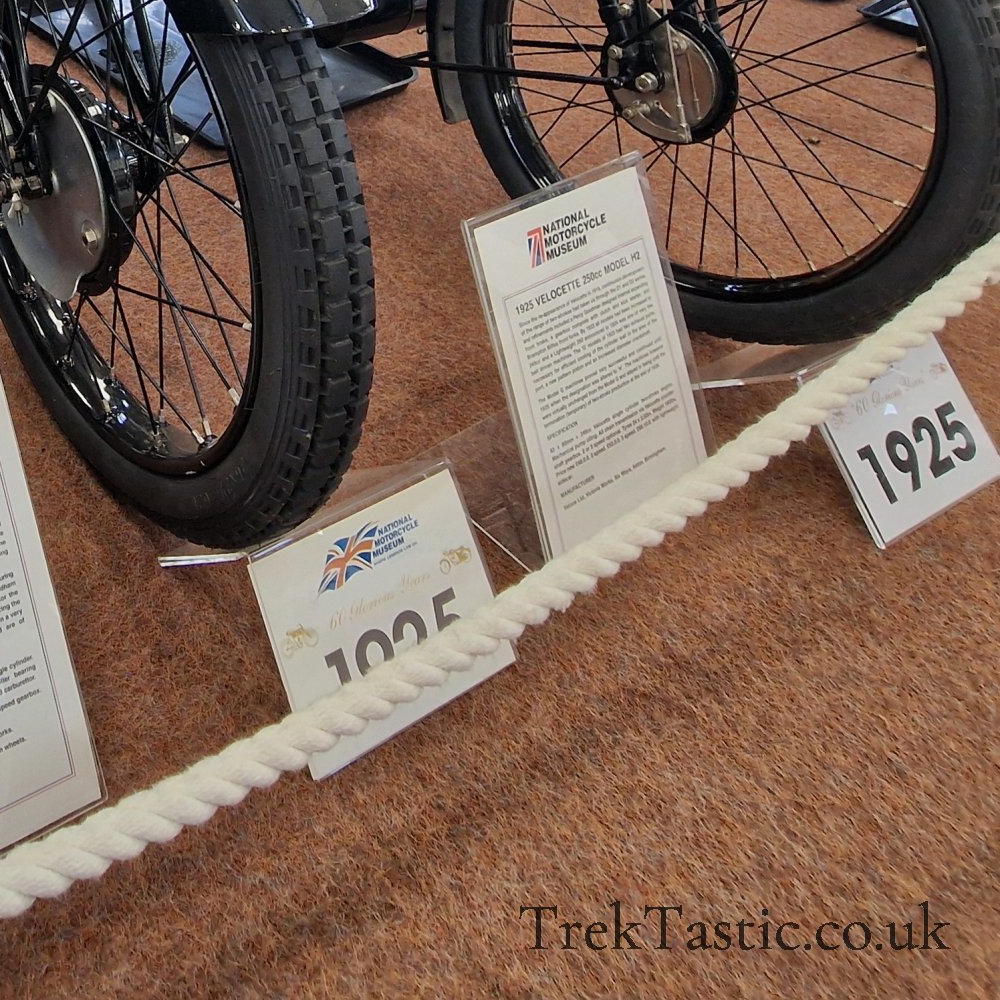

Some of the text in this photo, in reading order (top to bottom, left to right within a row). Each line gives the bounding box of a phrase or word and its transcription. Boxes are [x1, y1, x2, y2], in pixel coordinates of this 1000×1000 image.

[542, 208, 590, 236] NATIONAL
[544, 213, 607, 249] MOTORCYCLE
[545, 235, 588, 262] MUSEUM
[515, 300, 534, 316] 1925
[534, 278, 582, 307] VELOCETTE
[603, 258, 630, 276] MODEL
[856, 400, 977, 505] 1925
[374, 519, 420, 547] MOTORCYCLE
[377, 513, 413, 536] NATIONAL
[372, 537, 405, 559] MUSEUM
